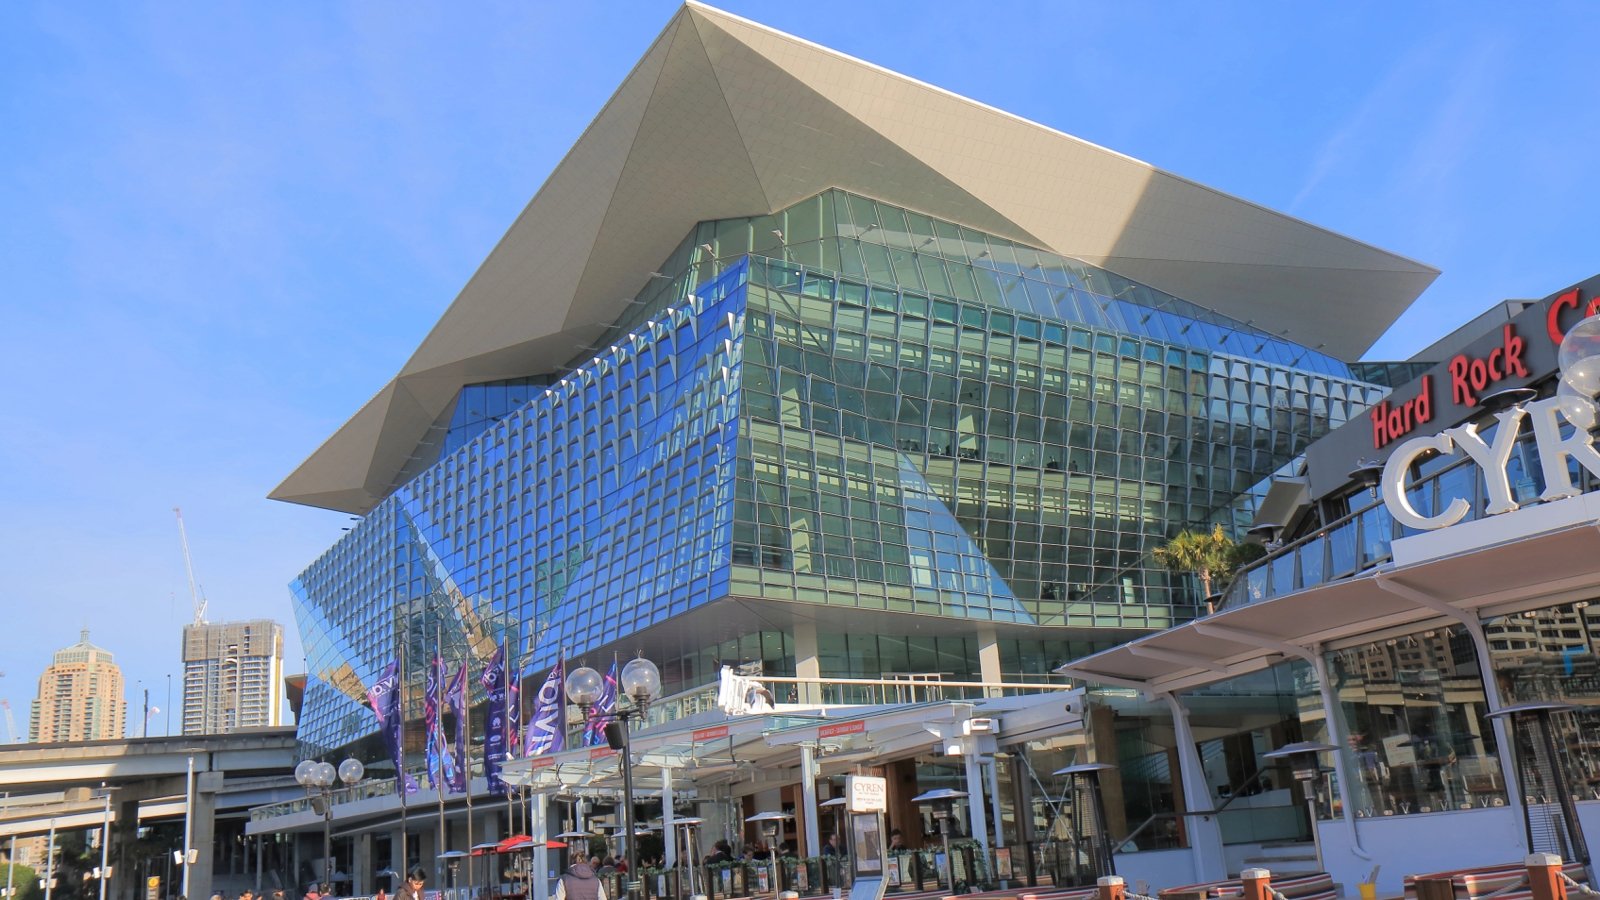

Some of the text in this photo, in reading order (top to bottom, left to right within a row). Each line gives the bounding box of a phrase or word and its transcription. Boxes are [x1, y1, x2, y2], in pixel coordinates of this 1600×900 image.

[1371, 376, 1432, 449] Hard
[1449, 324, 1529, 408] Rock
[853, 783, 884, 793] CYREN
